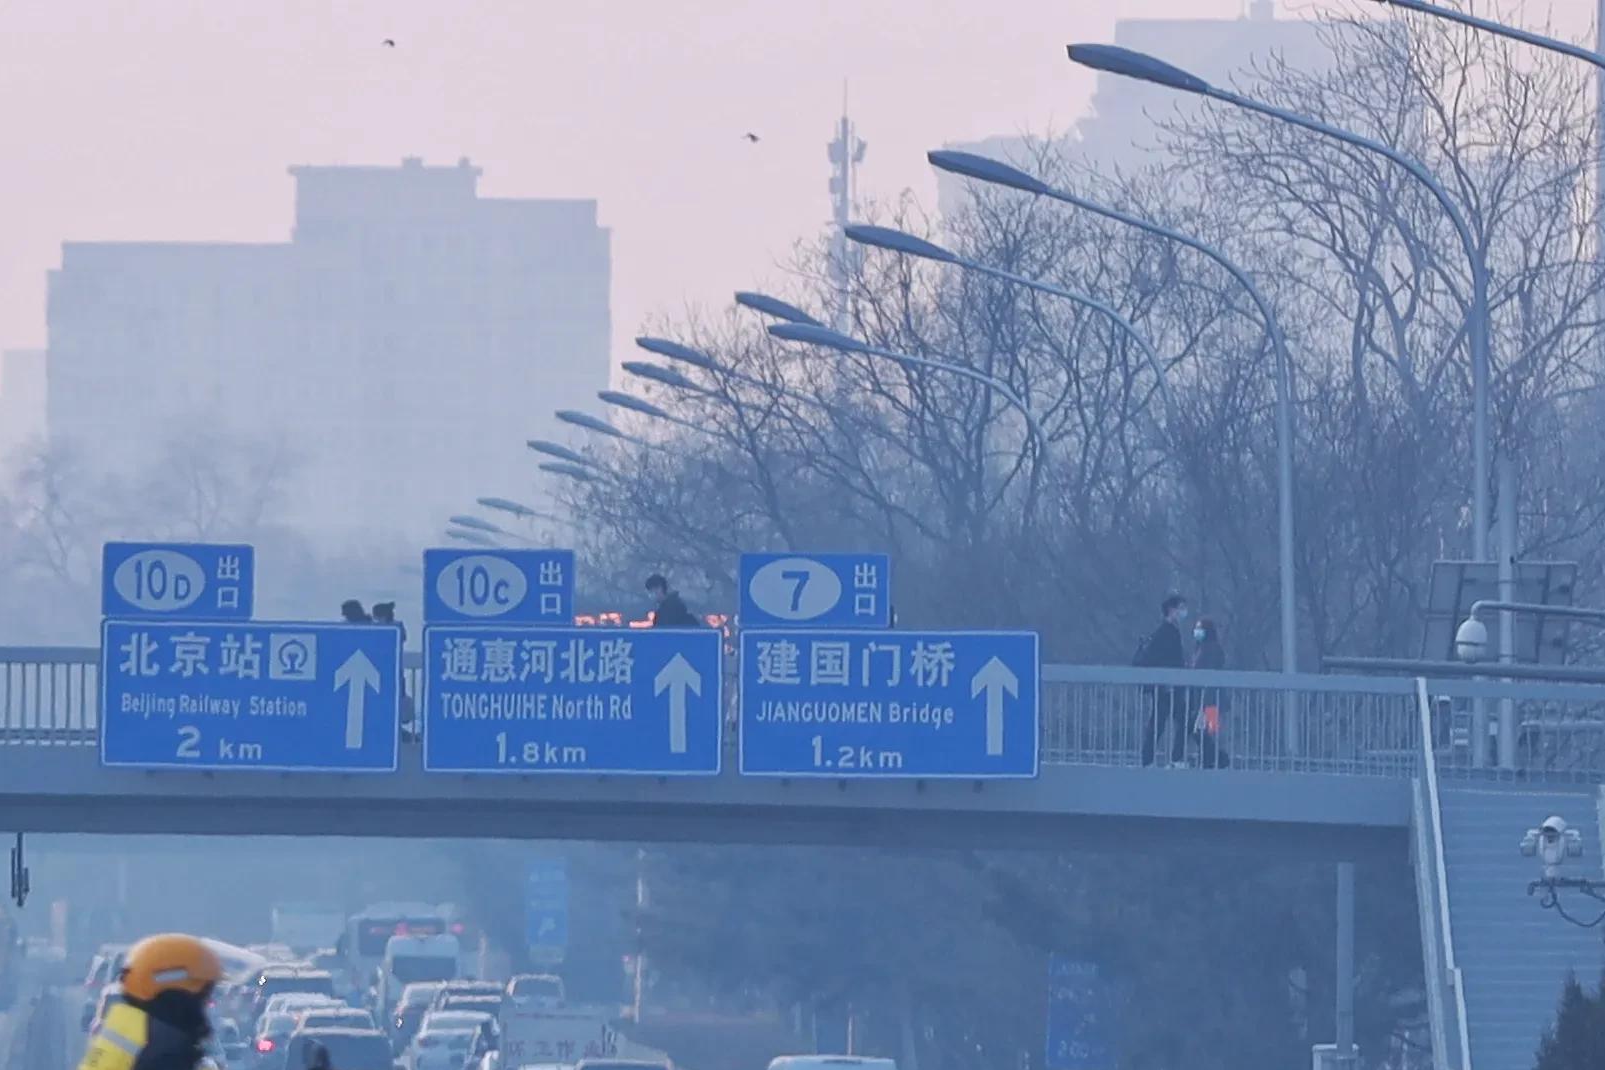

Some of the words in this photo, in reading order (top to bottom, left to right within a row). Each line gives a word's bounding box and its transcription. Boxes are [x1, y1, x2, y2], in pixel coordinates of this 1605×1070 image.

[134, 560, 191, 600] 10D
[217, 555, 240, 608] 出口
[539, 561, 563, 615] 出口
[781, 570, 811, 612] 7
[854, 563, 876, 616] 出口
[120, 631, 263, 679] 北京站
[441, 637, 635, 684] 通惠河北路
[756, 639, 955, 687] 建国门桥
[121, 692, 175, 719] Beijing
[179, 692, 240, 719] Railway
[250, 695, 307, 717] Station
[441, 692, 547, 720] TONGHUIHE
[552, 694, 604, 720] North
[609, 694, 633, 720] Rd
[756, 701, 882, 724] JIANGUOMEN
[889, 702, 954, 730] Bridge
[176, 725, 201, 758] 2
[220, 738, 262, 760] km
